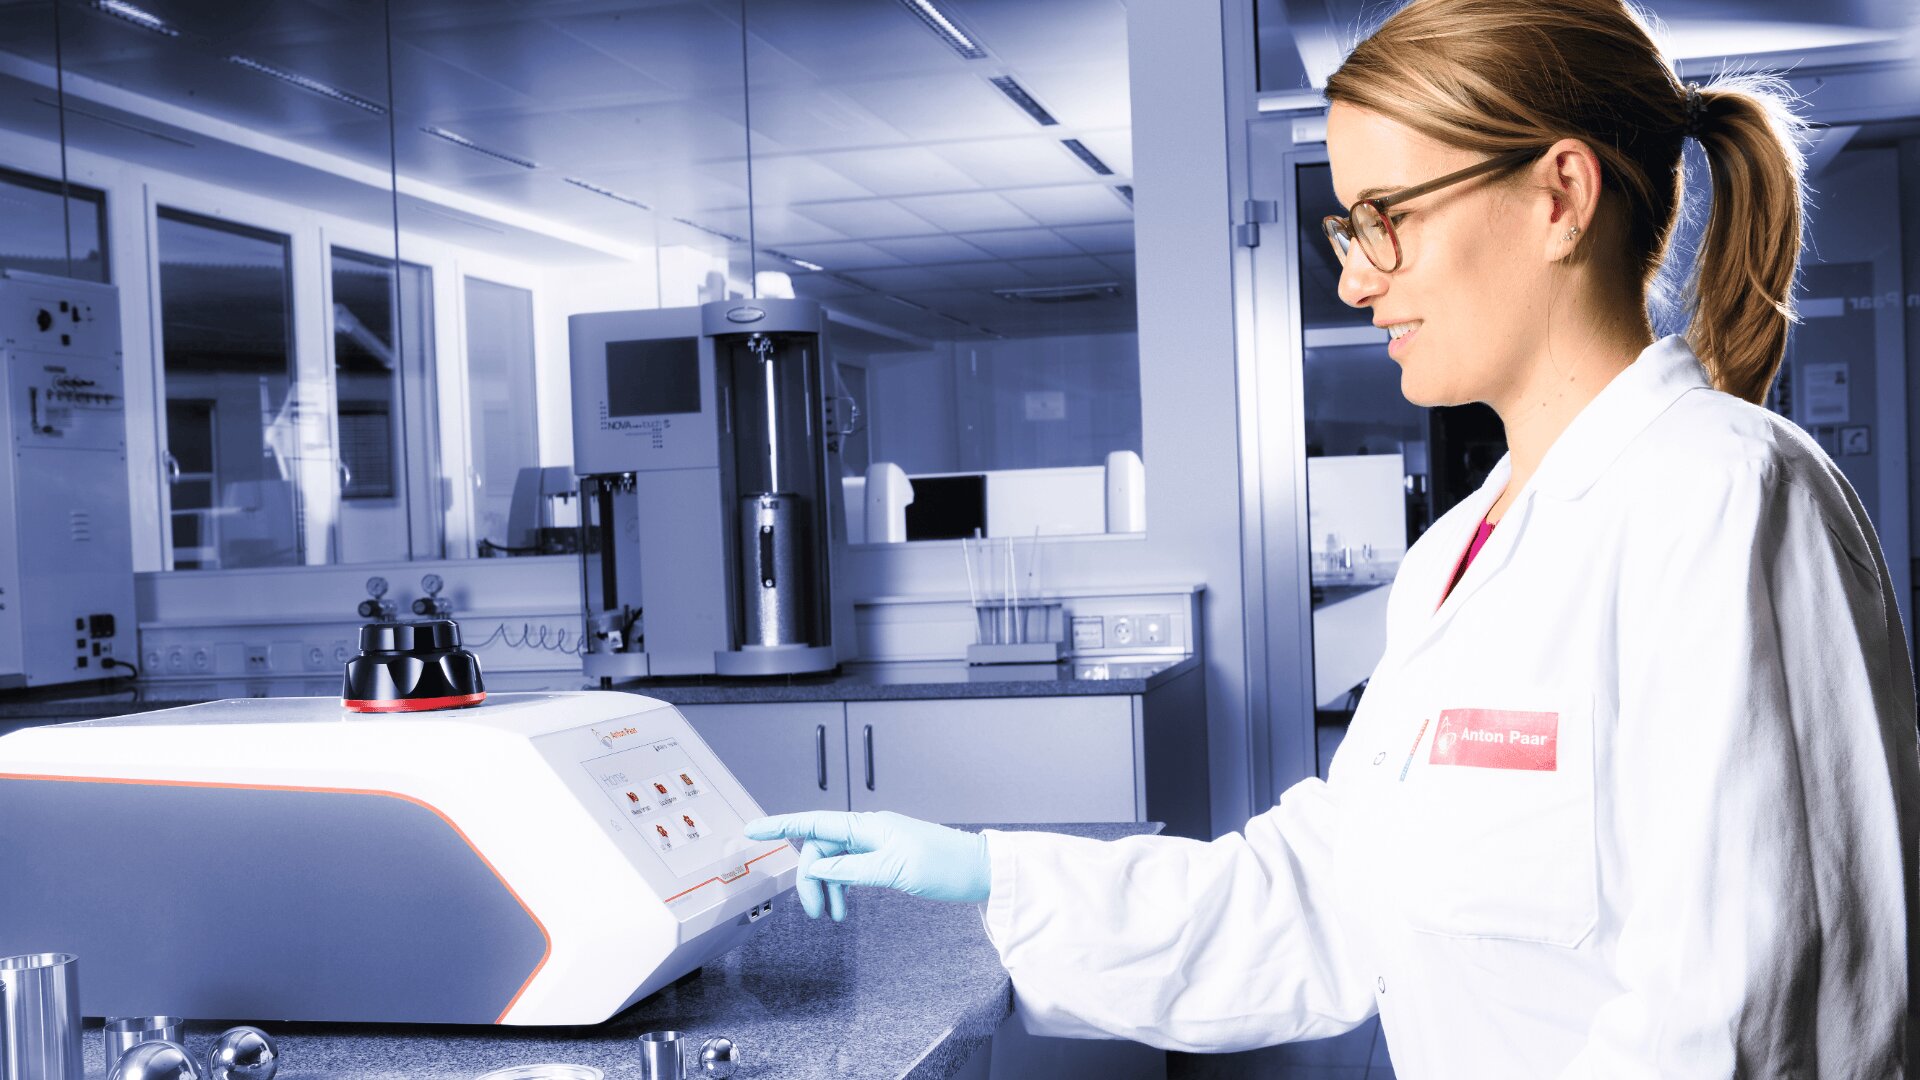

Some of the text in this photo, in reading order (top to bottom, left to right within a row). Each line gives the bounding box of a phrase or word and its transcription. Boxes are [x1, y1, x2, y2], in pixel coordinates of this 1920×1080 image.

[608, 420, 632, 431] NOVA
[610, 727, 638, 739] Anton Paar
[1461, 727, 1548, 746] Anton Paar
[602, 772, 629, 788] Home
